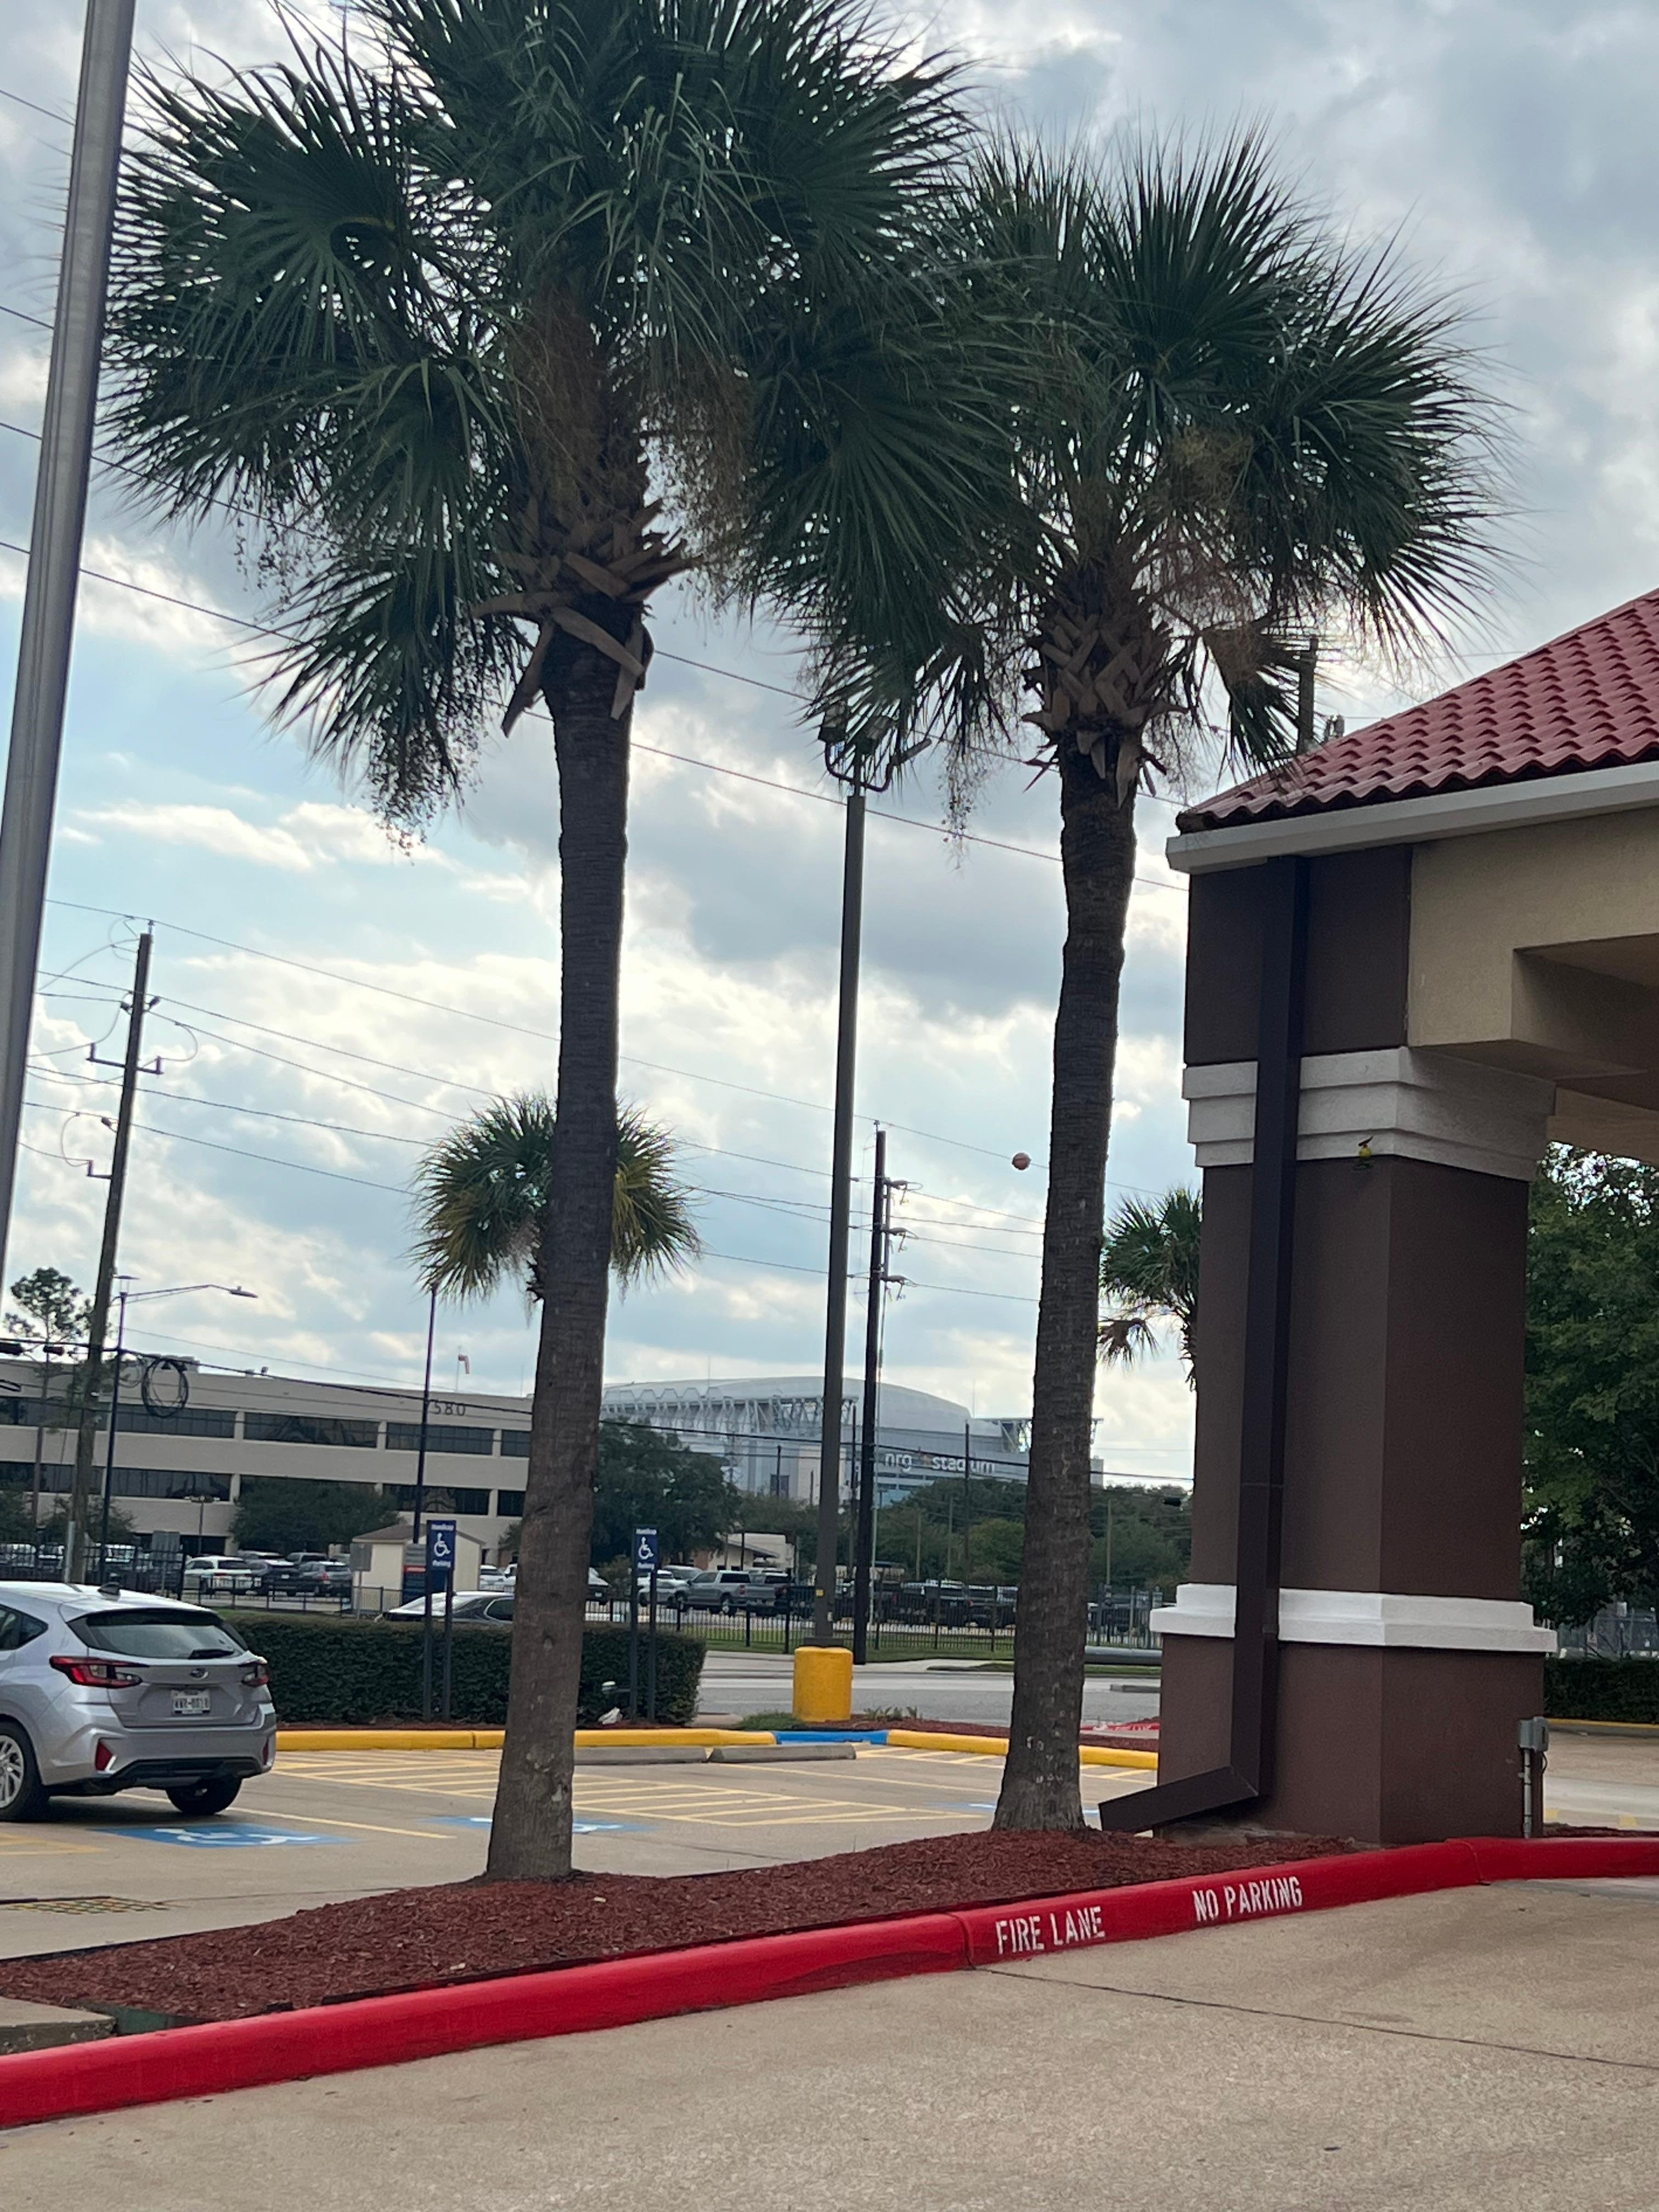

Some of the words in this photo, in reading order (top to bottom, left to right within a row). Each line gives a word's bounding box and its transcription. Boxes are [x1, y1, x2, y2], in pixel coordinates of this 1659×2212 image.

[425, 1398, 466, 1416] 580
[885, 1453, 912, 1473] nrg
[932, 1456, 995, 1474] stadum
[1192, 1888, 1220, 1922] NO
[1223, 1876, 1303, 1917] PARKING
[995, 1916, 1045, 1955] FIRE
[1050, 1906, 1105, 1946] LANE
